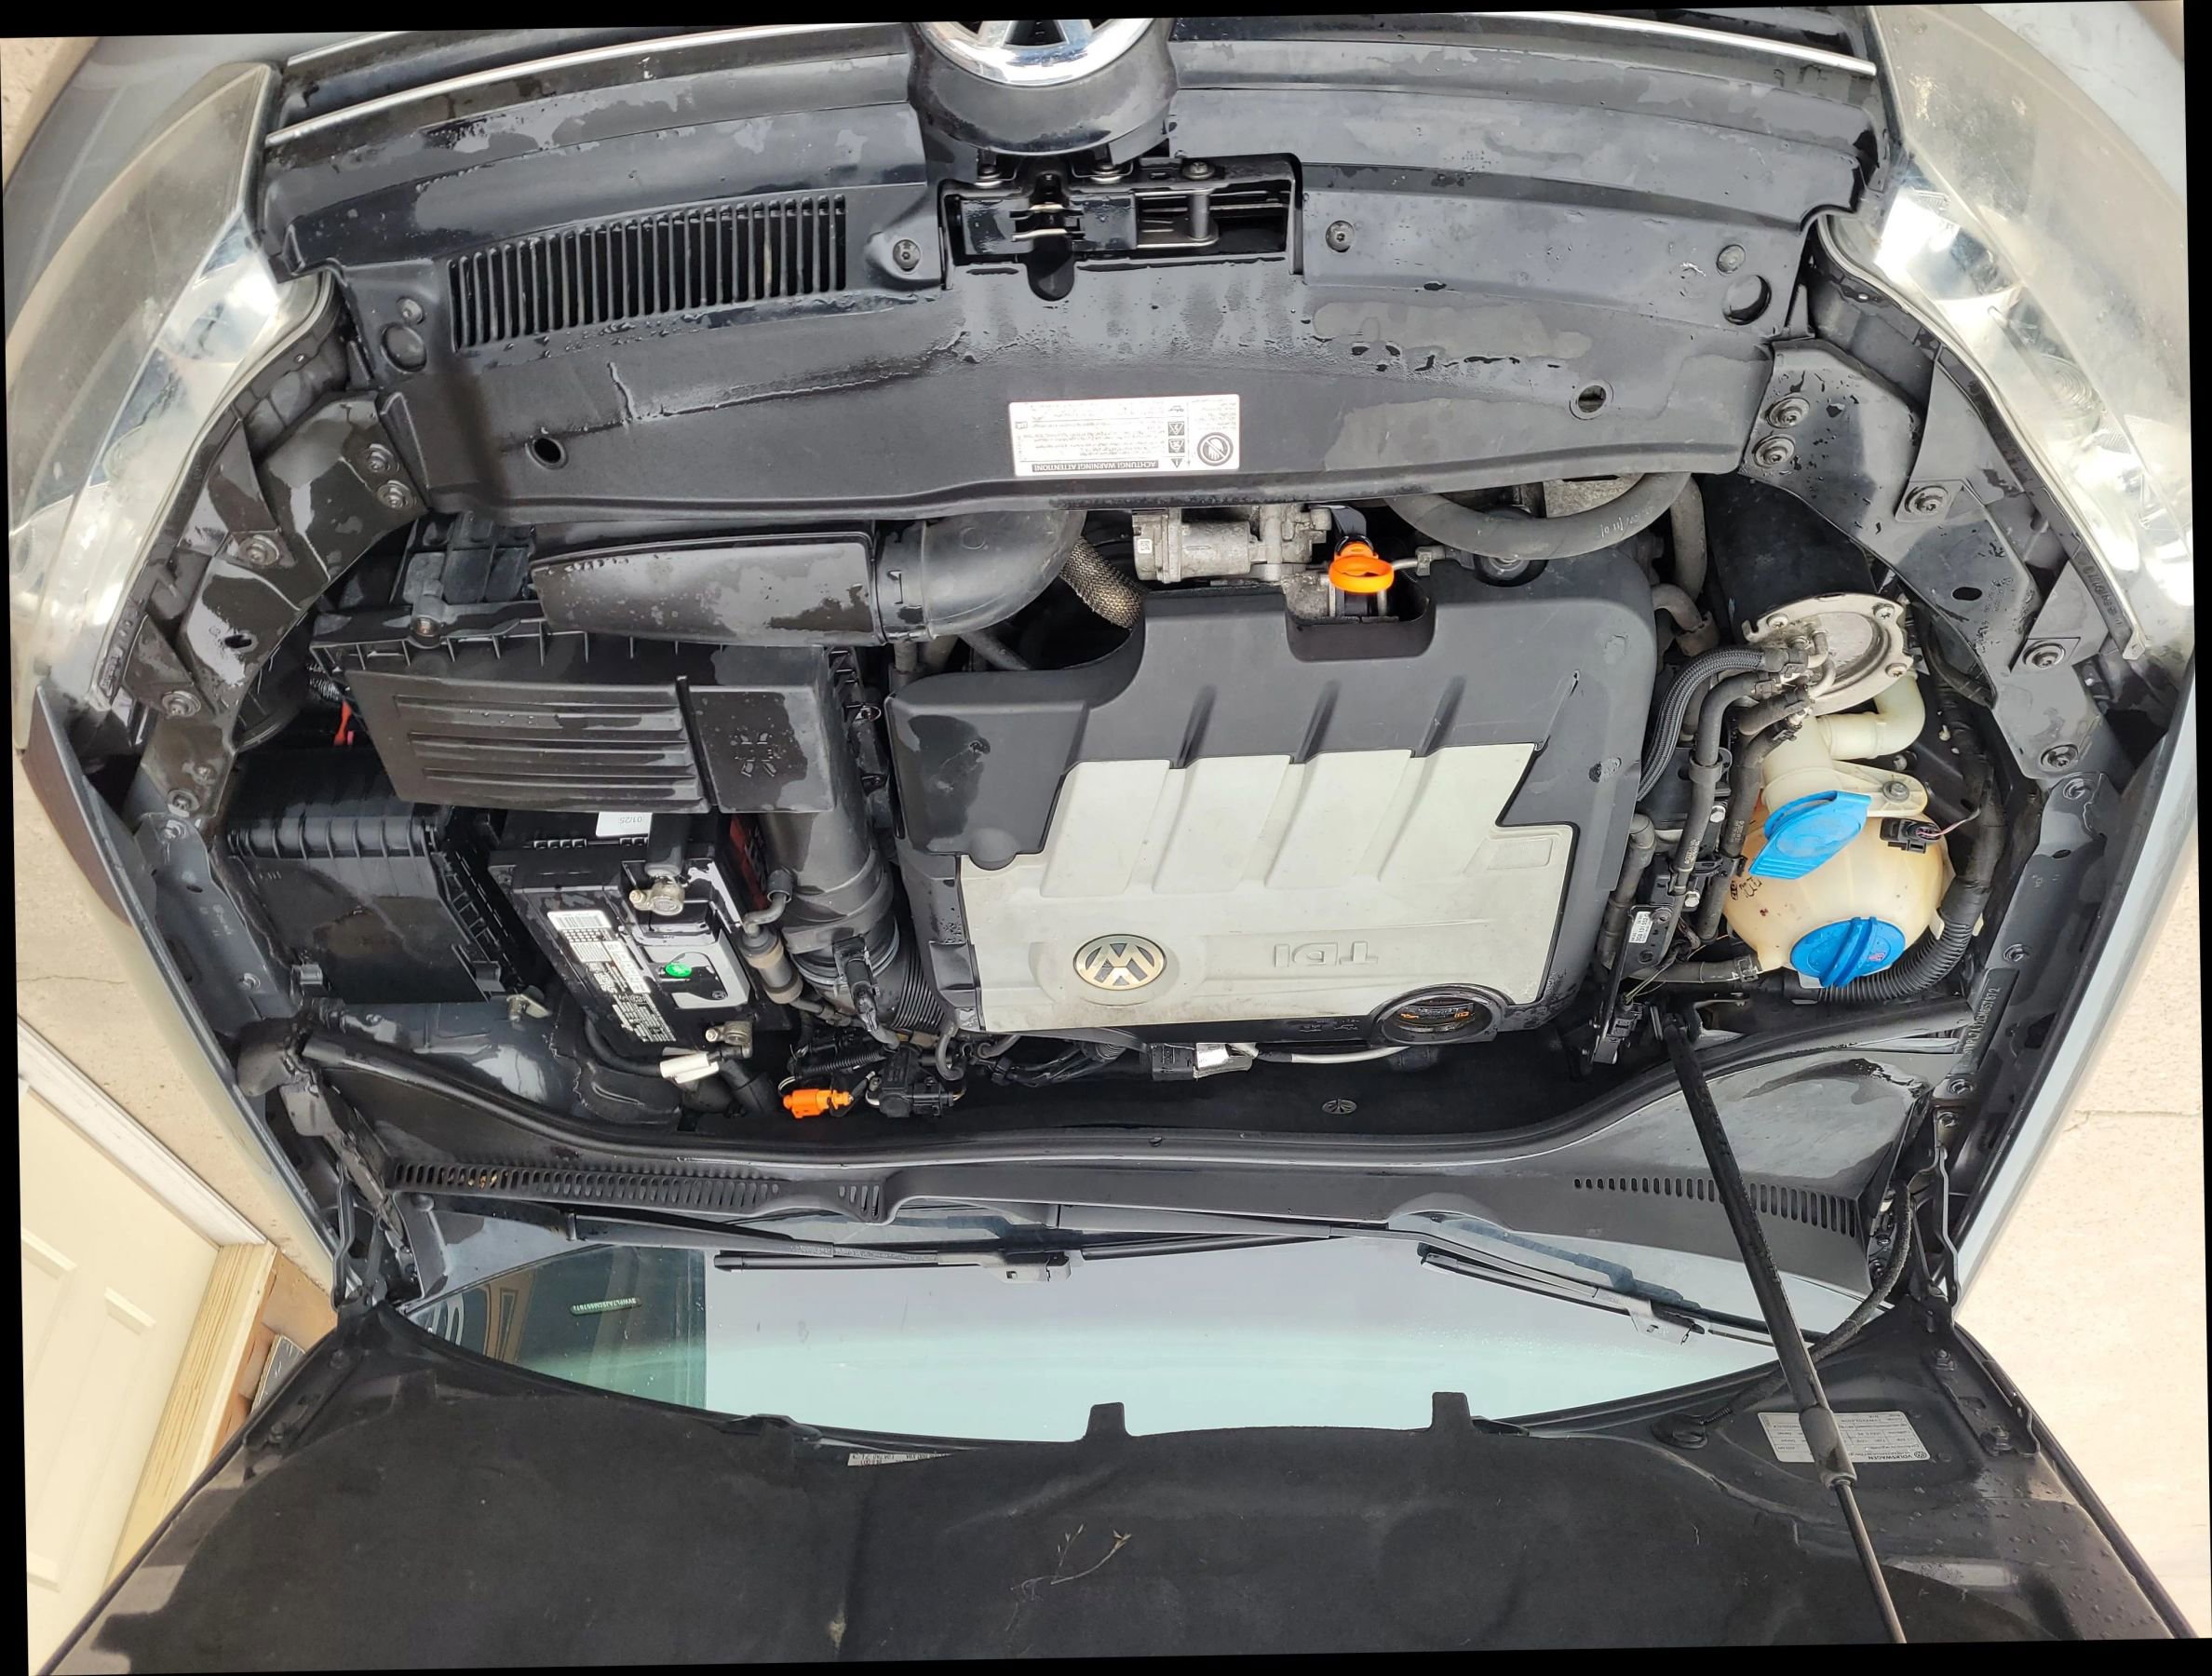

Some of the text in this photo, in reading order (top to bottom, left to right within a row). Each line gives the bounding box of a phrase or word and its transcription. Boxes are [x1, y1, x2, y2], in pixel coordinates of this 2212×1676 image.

[1033, 460, 1157, 472] ACHTUNG! WARNING! ATTENTION!
[619, 816, 642, 824] 01/25
[1273, 941, 1379, 968] TDI
